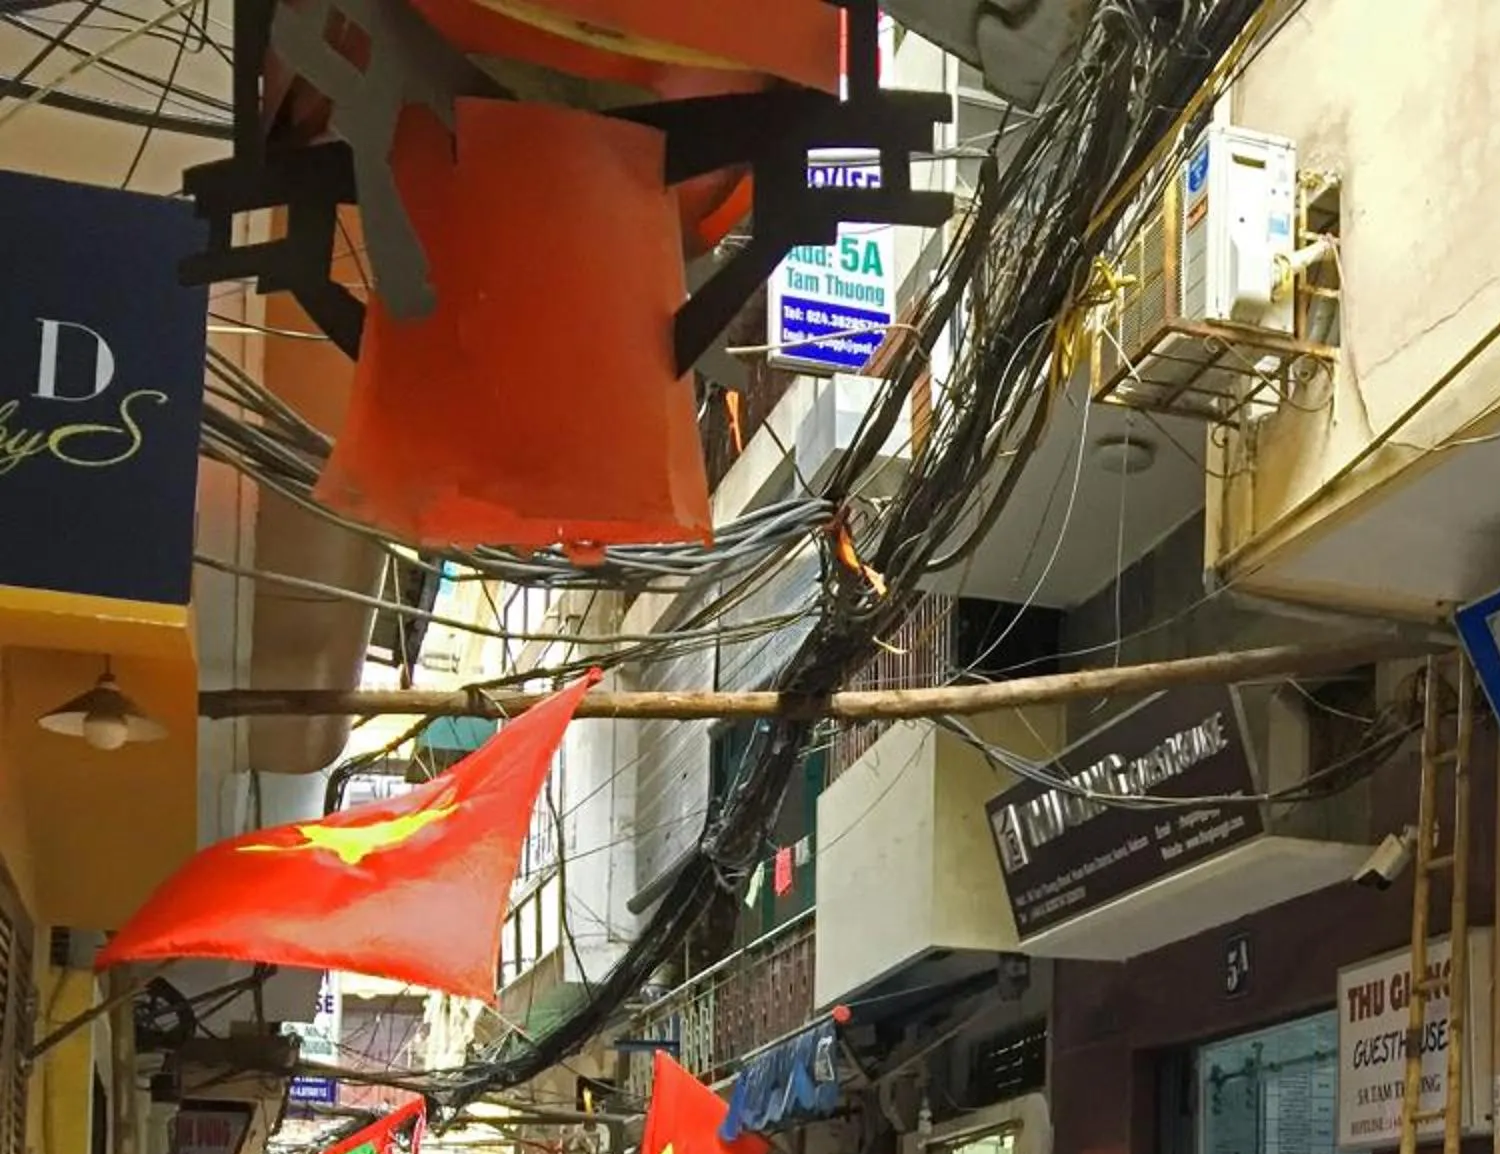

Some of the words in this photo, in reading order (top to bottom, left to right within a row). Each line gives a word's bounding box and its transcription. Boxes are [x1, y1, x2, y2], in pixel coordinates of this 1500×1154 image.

[839, 236, 884, 278] 5A
[785, 267, 820, 294] Tam
[825, 273, 886, 308] Thuong
[32, 317, 115, 402] D
[1348, 979, 1386, 1024] THU
[1352, 1018, 1450, 1070] GUESTHUSE
